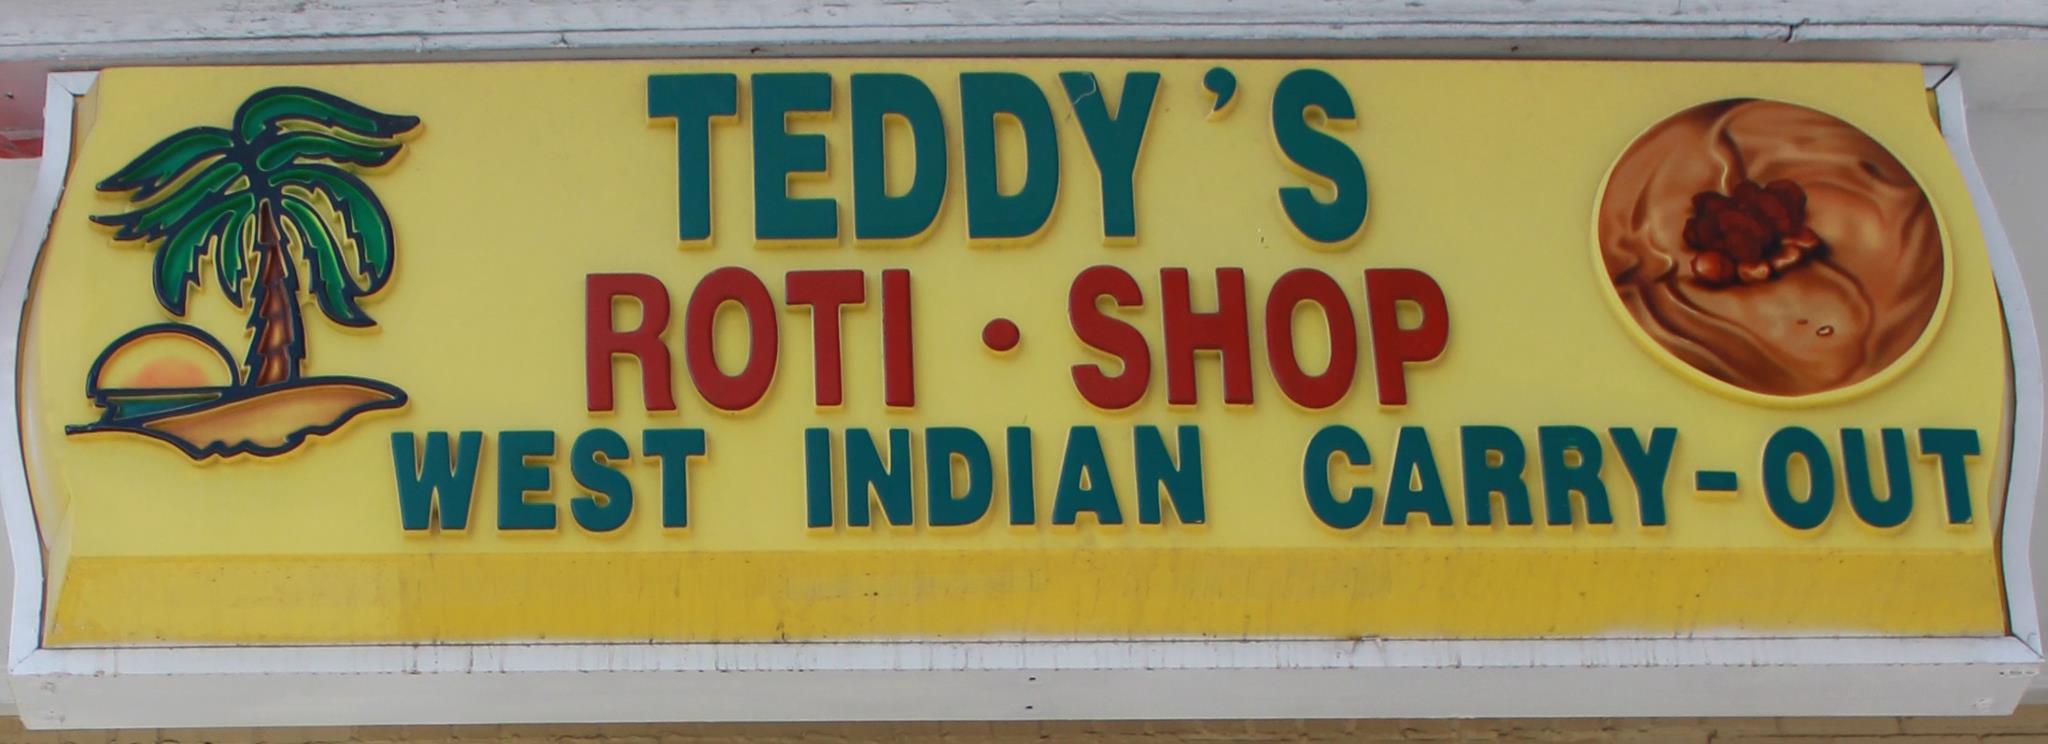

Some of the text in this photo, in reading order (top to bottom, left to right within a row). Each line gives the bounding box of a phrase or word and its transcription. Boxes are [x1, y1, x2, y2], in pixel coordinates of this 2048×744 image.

[648, 67, 1369, 243] TEDDY'S
[585, 265, 1449, 412] ROTI SHOP
[392, 425, 1982, 532] WEST INDIAN CARRY-OUT
